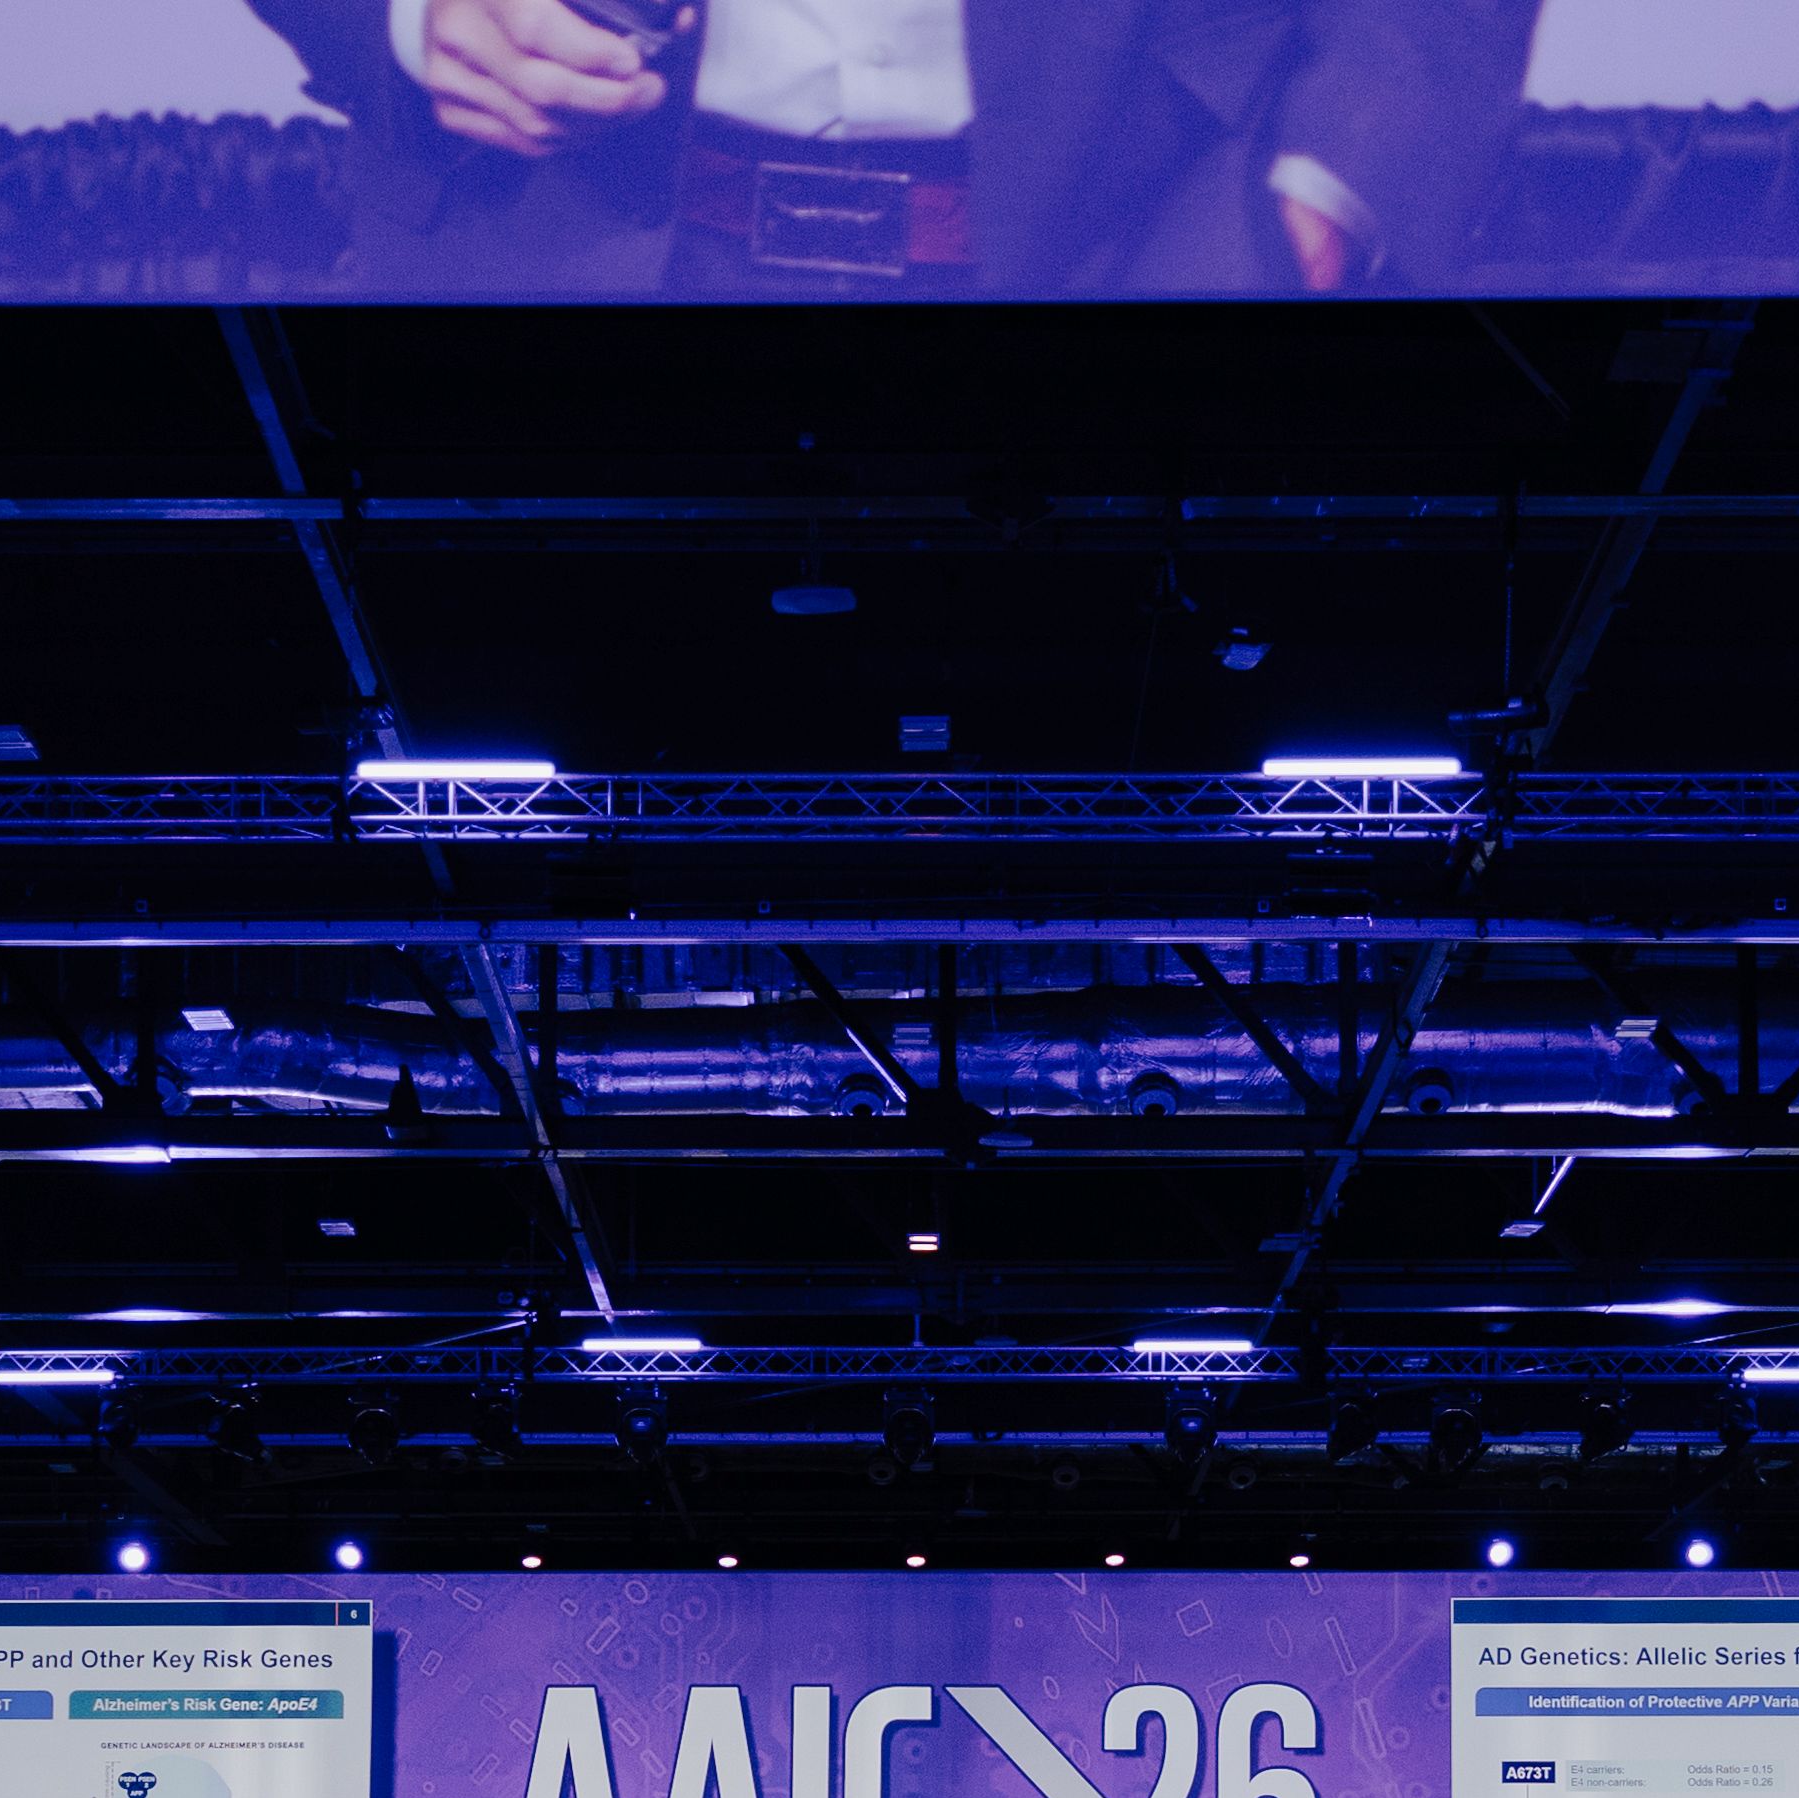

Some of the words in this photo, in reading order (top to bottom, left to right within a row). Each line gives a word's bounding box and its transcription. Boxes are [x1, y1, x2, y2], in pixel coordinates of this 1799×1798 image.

[350, 1609, 357, 1619] 6
[32, 1650, 73, 1668] and
[82, 1650, 145, 1668] Other
[153, 1650, 195, 1673] Key
[204, 1650, 252, 1668] Risk
[261, 1649, 333, 1668] Genes
[1479, 1647, 1512, 1665] AD
[1521, 1647, 1628, 1666] Genetics:
[1636, 1647, 1707, 1666] Allelic
[1715, 1647, 1786, 1665] Series
[93, 1698, 180, 1711] Alzheimer's
[184, 1698, 216, 1711] Risk
[220, 1698, 264, 1711] Gene:
[267, 1697, 318, 1714] ApoE4
[1529, 1695, 1625, 1708] Identification
[1629, 1695, 1645, 1708] of
[1648, 1695, 1723, 1708] Protective
[1726, 1695, 1760, 1708] APP
[1506, 1766, 1552, 1779] A673T
[1571, 1765, 1584, 1774] E4
[1687, 1764, 1714, 1774] Odds
[1716, 1764, 1741, 1774] Ratio
[1752, 1764, 1774, 1774] 0.15
[1571, 1777, 1584, 1787] E4
[1687, 1777, 1713, 1787] Odds
[1715, 1777, 1741, 1787] Ratio
[1752, 1777, 1773, 1787] 0.26
